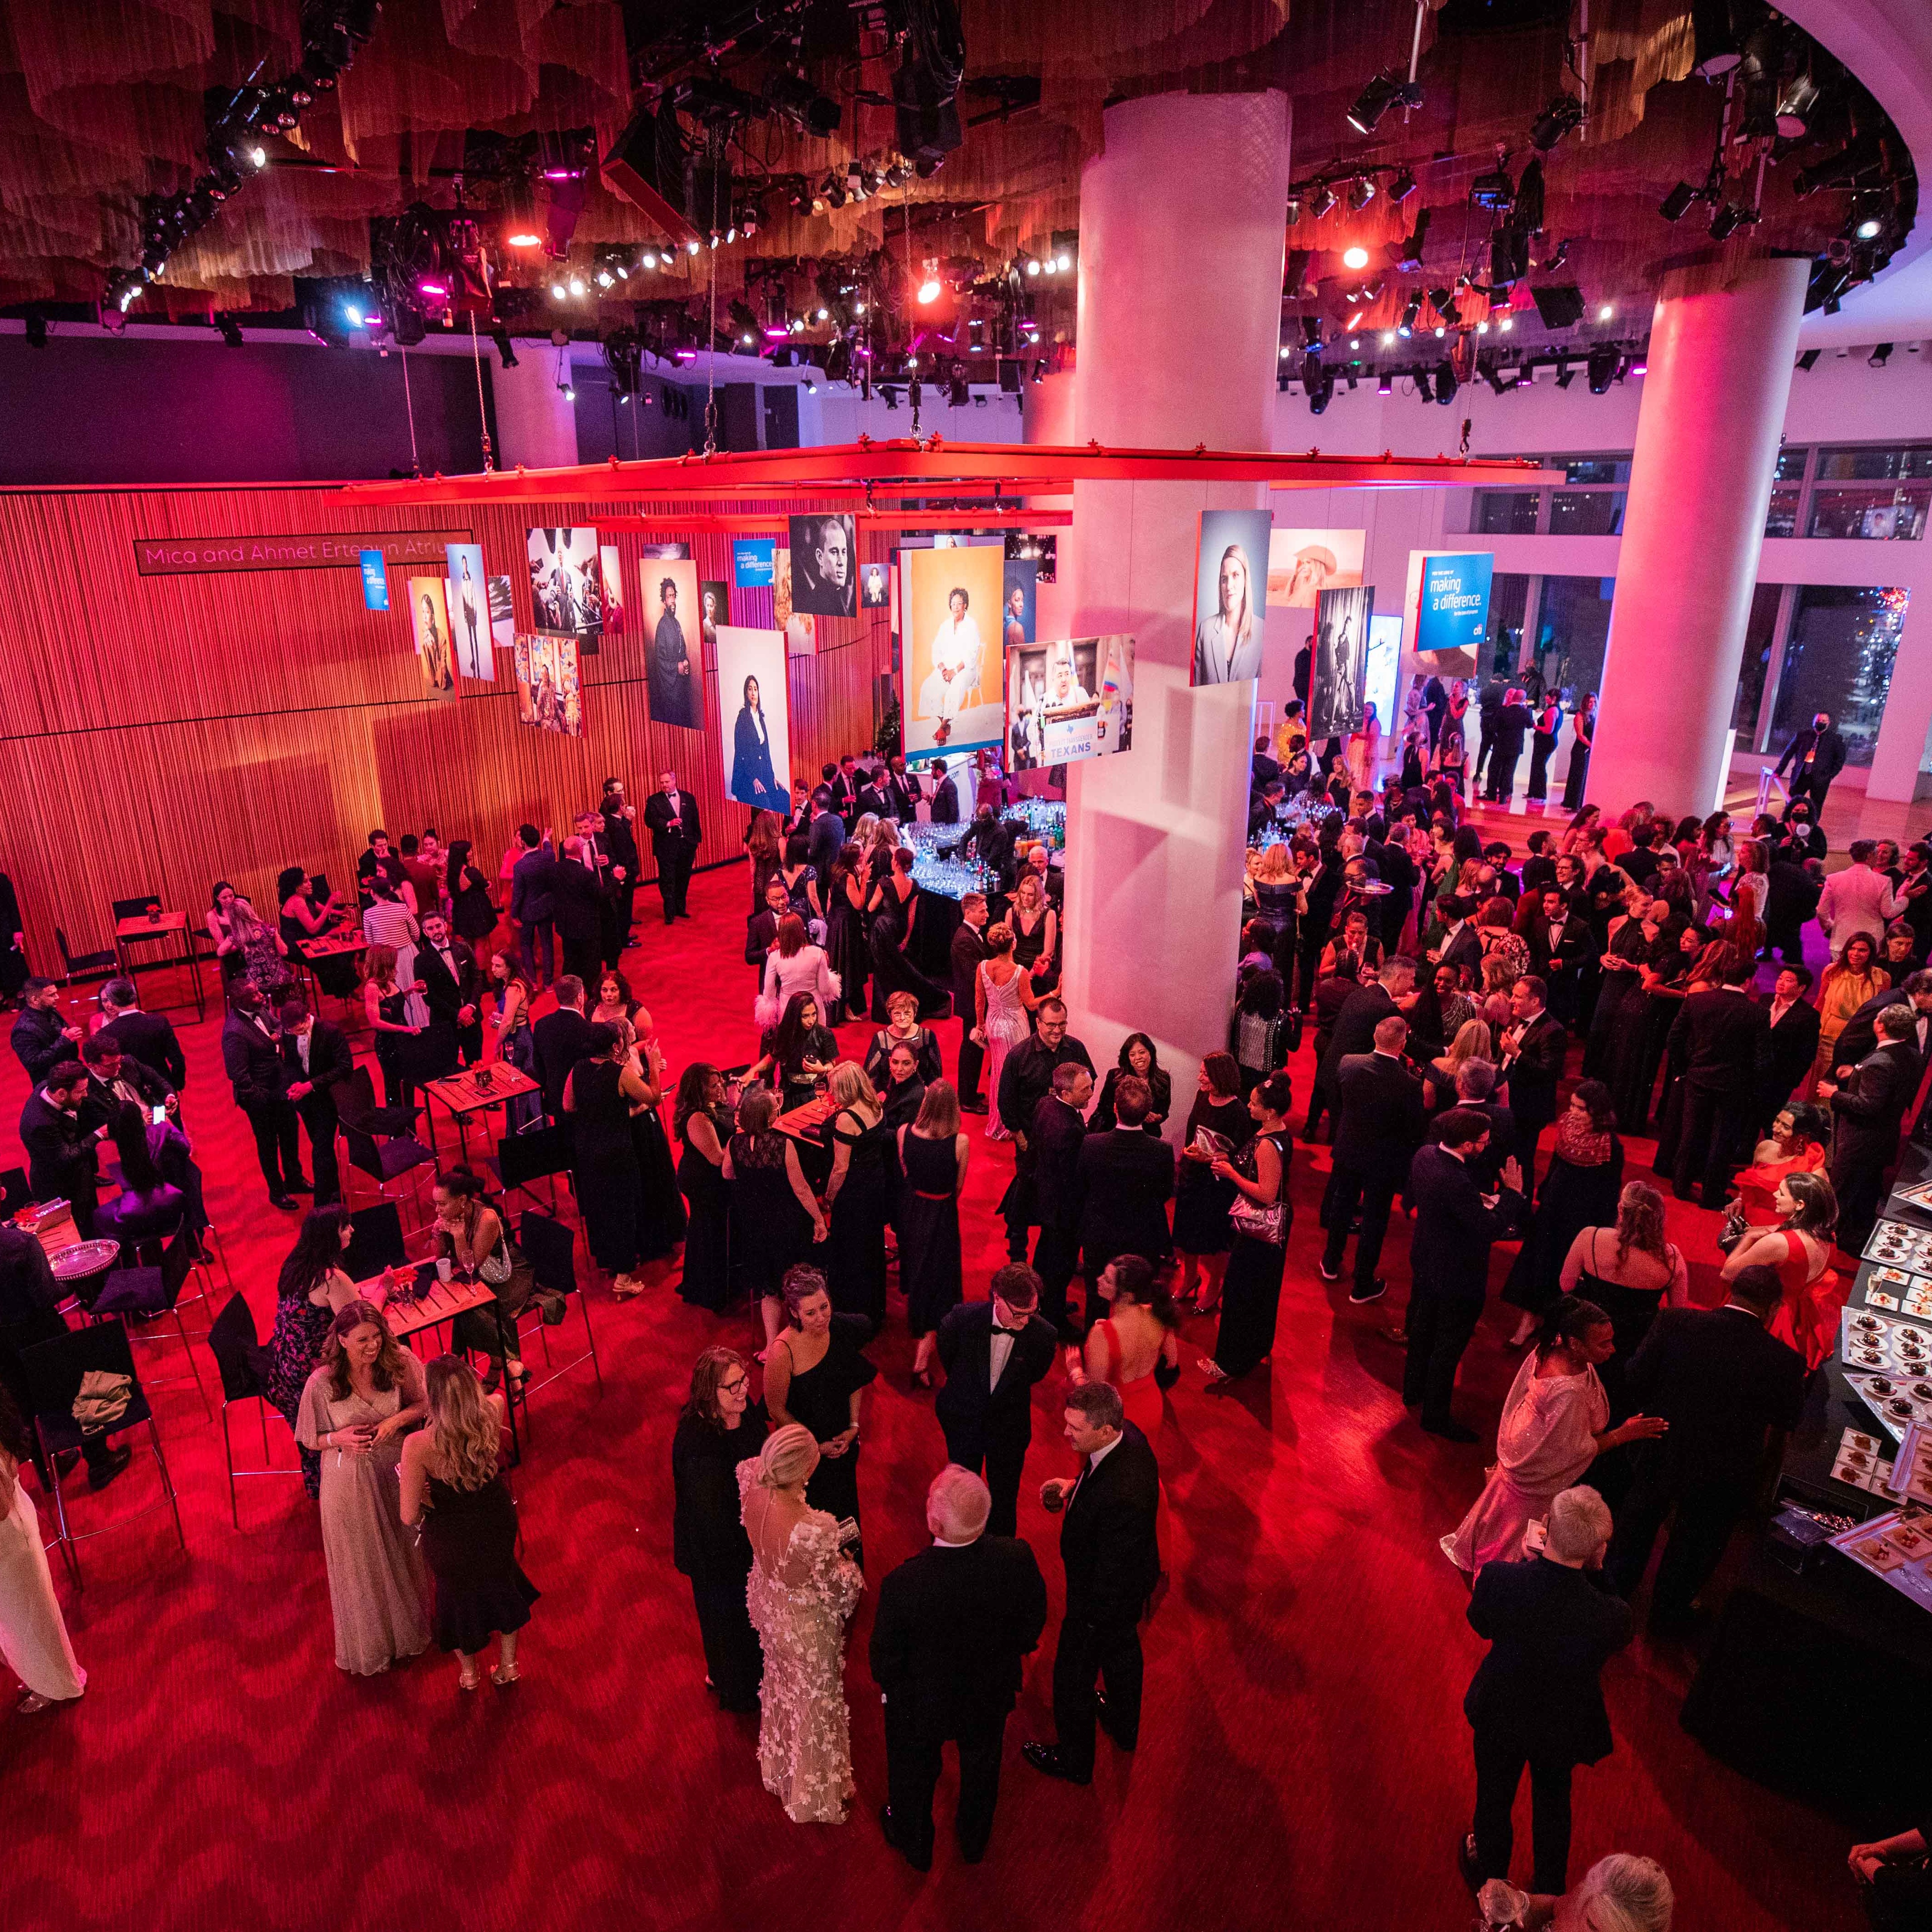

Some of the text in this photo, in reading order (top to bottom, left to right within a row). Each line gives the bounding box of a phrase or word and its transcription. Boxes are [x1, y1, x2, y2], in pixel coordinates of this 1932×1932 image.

[145, 548, 197, 564] Mica
[203, 546, 244, 562] and
[252, 544, 316, 559] Ahmet
[403, 539, 446, 554] Atriu
[737, 554, 757, 562] making
[1430, 577, 1462, 594] making
[1433, 593, 1482, 611] a difference.
[1473, 625, 1483, 635] citi
[1051, 742, 1091, 758] TEXANS
